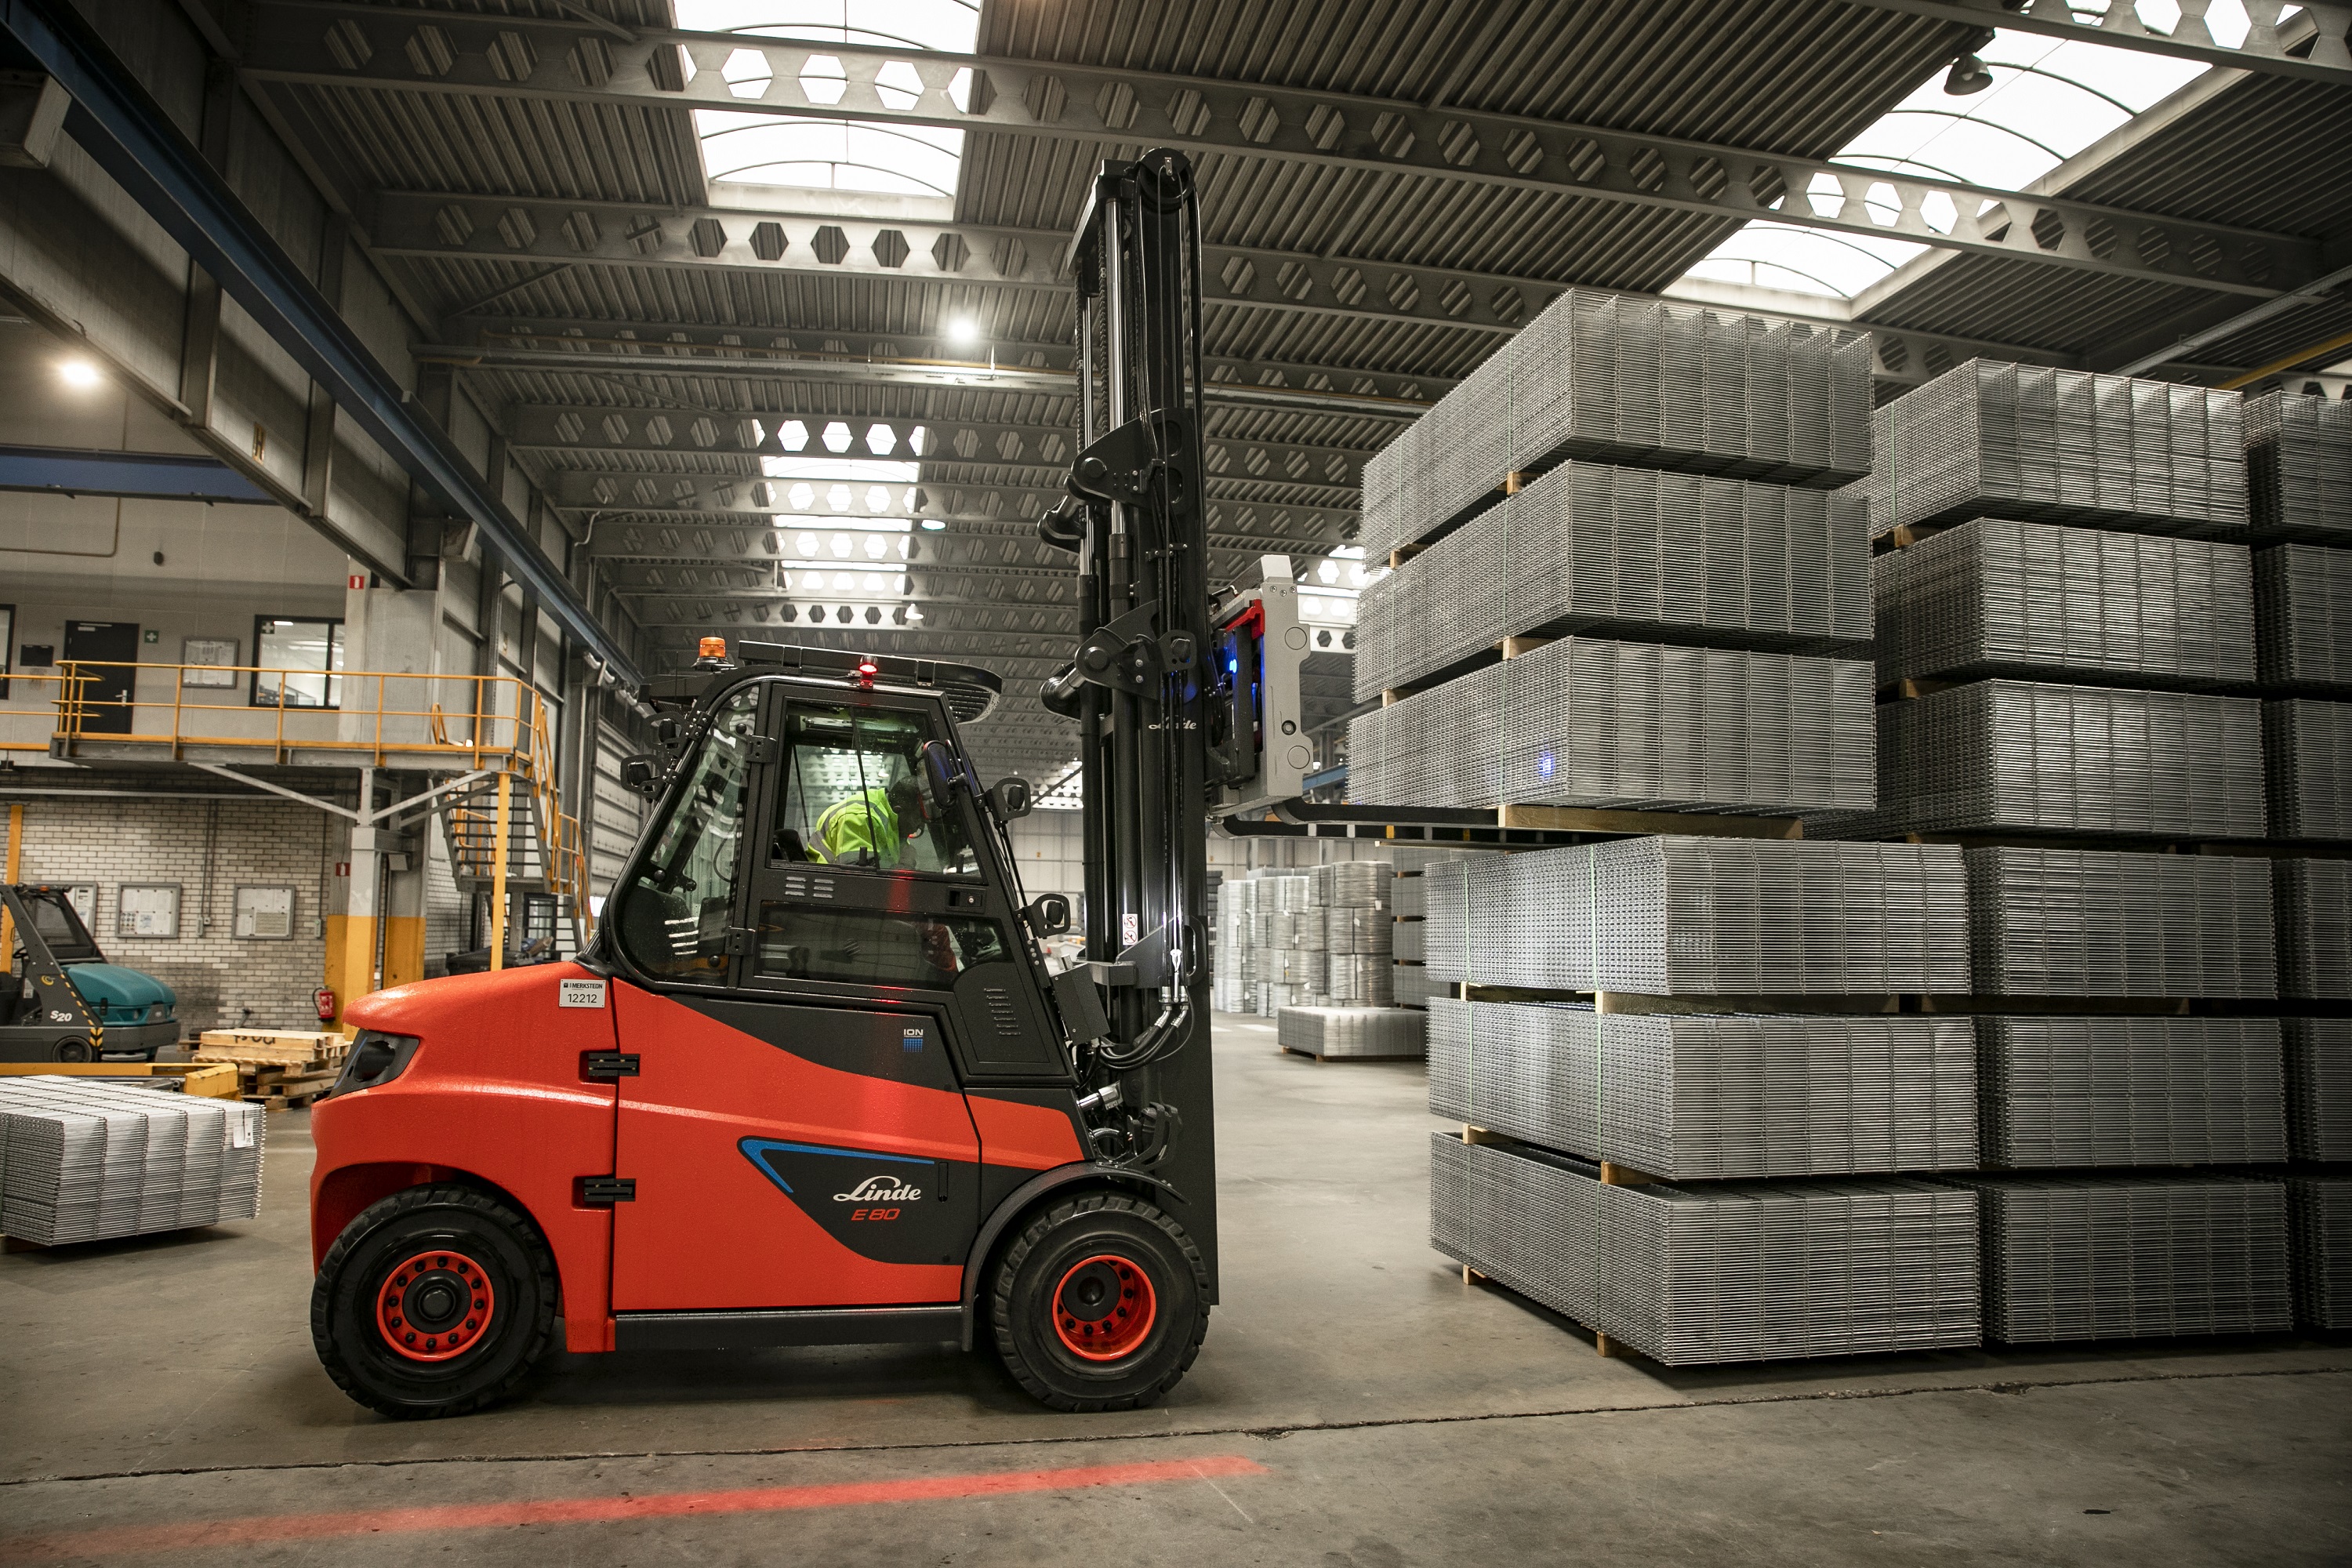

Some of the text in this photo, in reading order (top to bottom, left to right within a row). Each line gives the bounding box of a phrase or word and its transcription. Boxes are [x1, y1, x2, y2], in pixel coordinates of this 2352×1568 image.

[568, 993, 597, 1004] 12212
[50, 1010, 73, 1022] S20
[833, 1175, 921, 1202] Linde
[851, 1208, 901, 1221] E 80
